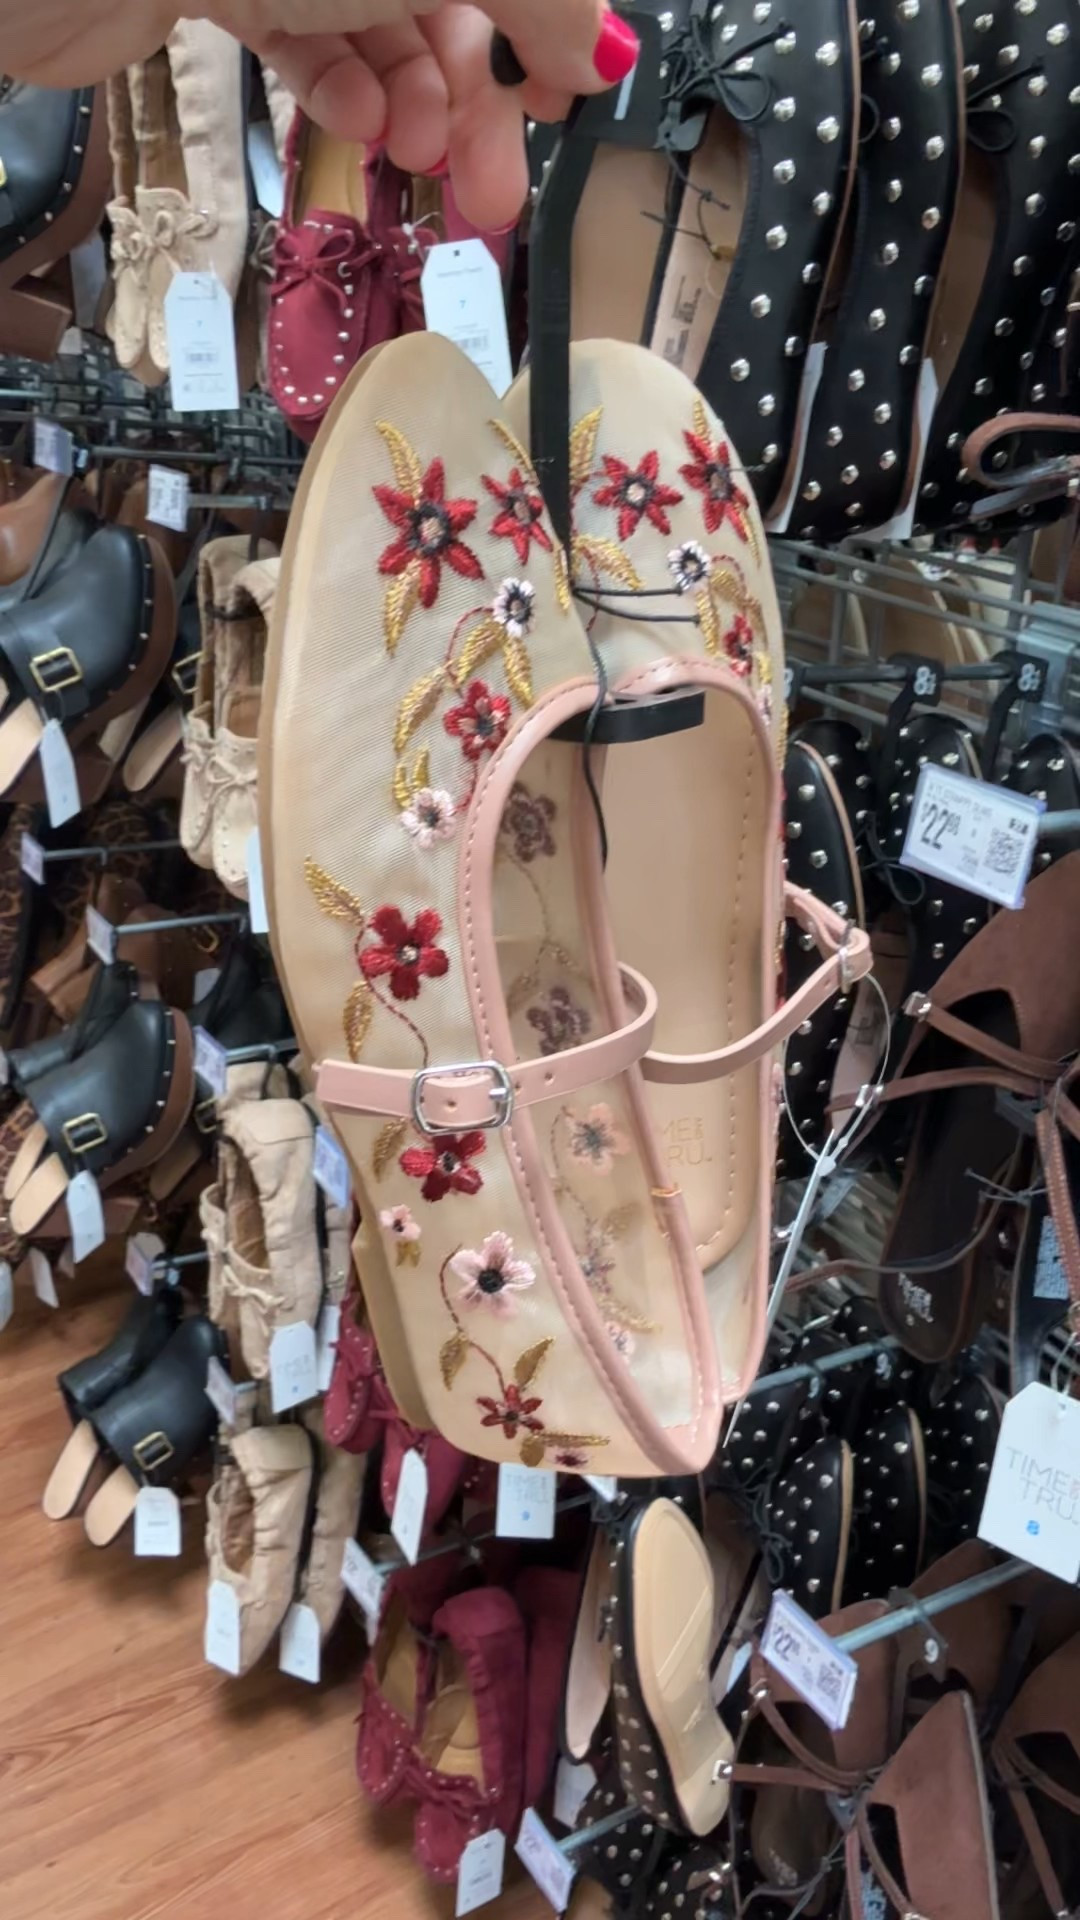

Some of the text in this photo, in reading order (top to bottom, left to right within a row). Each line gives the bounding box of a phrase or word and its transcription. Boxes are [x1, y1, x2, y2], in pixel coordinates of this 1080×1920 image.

[666, 1143, 704, 1168] RU
[1006, 1446, 1071, 1496] TIME
[1019, 1476, 1076, 1520] TRU
